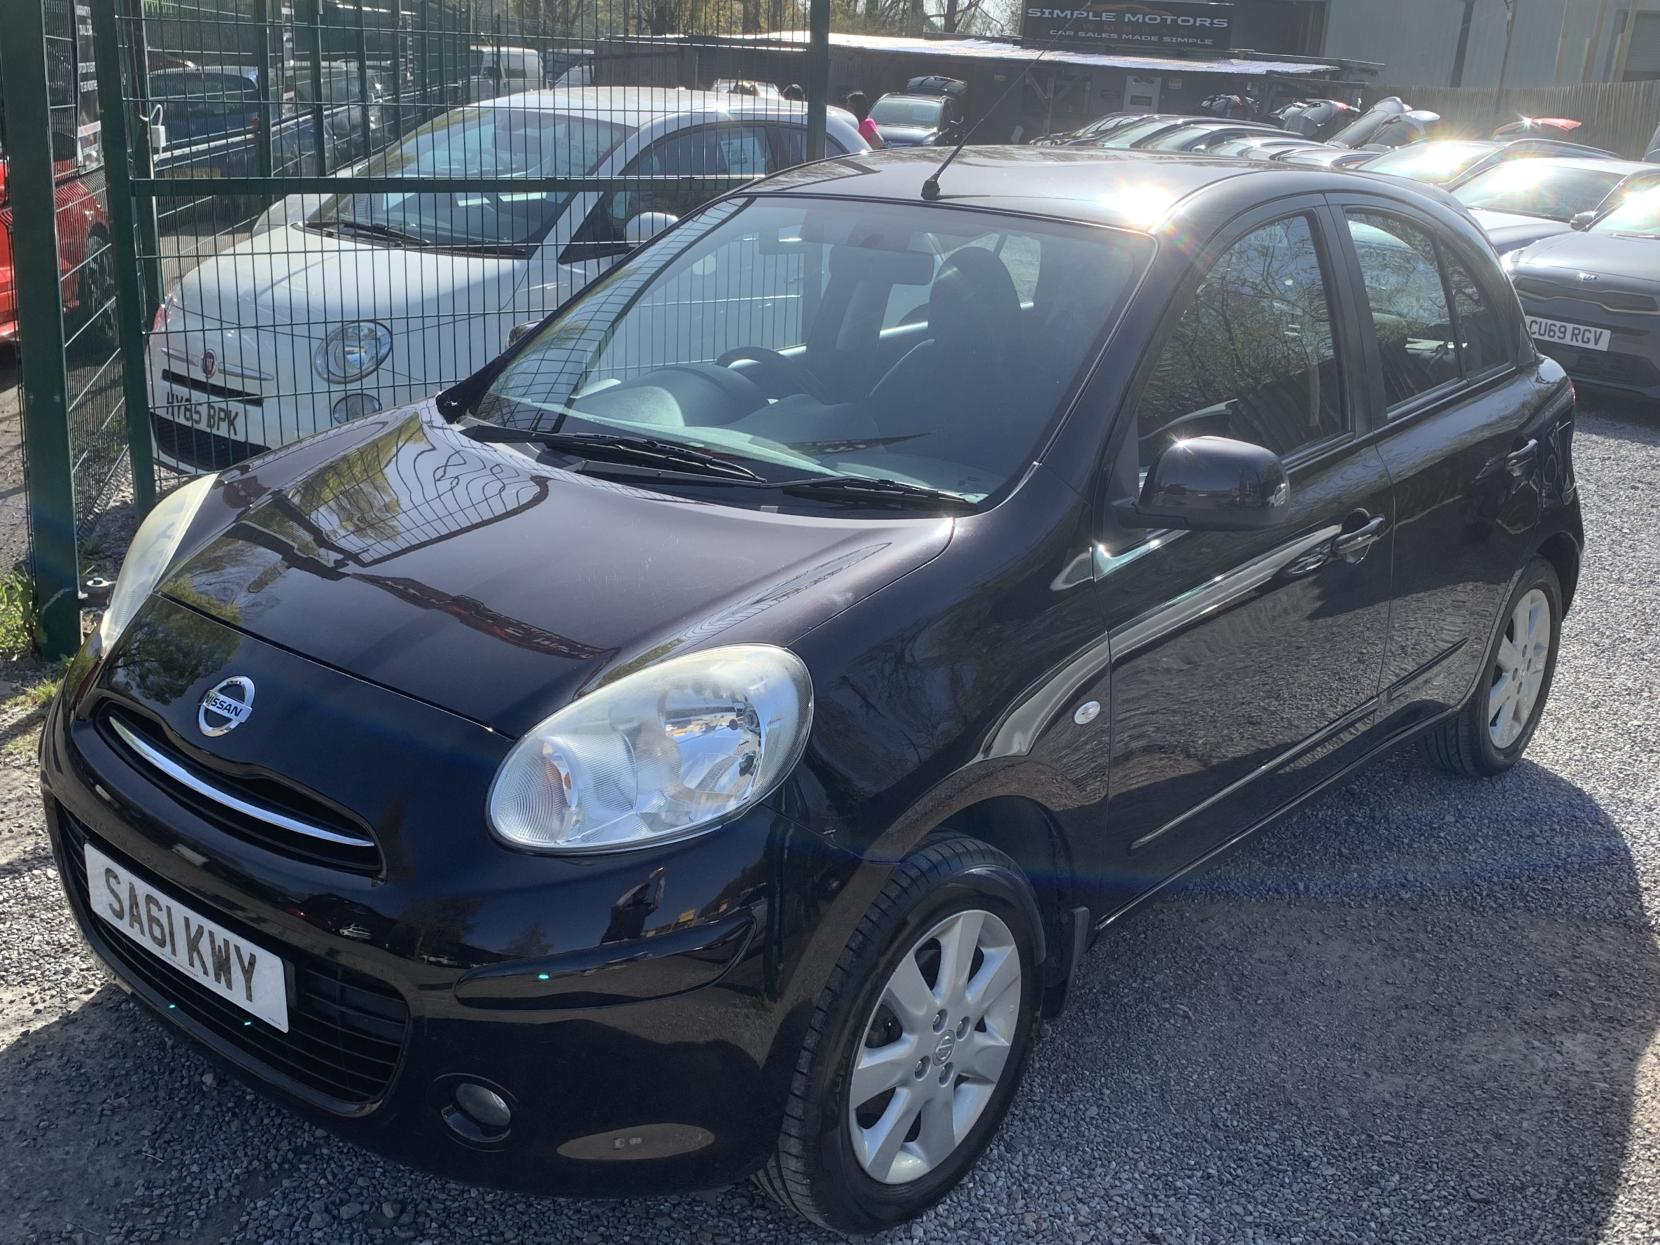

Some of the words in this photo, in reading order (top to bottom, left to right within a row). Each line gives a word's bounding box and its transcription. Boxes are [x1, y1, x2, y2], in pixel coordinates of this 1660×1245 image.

[1027, 8, 1116, 22] SIMPLE
[1124, 13, 1229, 28] MOTORS
[1050, 29, 1075, 37] CAR
[1078, 31, 1118, 39] SALES
[1122, 33, 1159, 42] MADE
[1163, 36, 1214, 45] SIMPLE
[1529, 319, 1568, 340] CU69
[1570, 326, 1604, 346] RGV
[206, 404, 239, 436] BPK
[204, 693, 243, 717] NISSAN
[104, 867, 177, 957] SA61
[183, 915, 257, 1002] KWY
